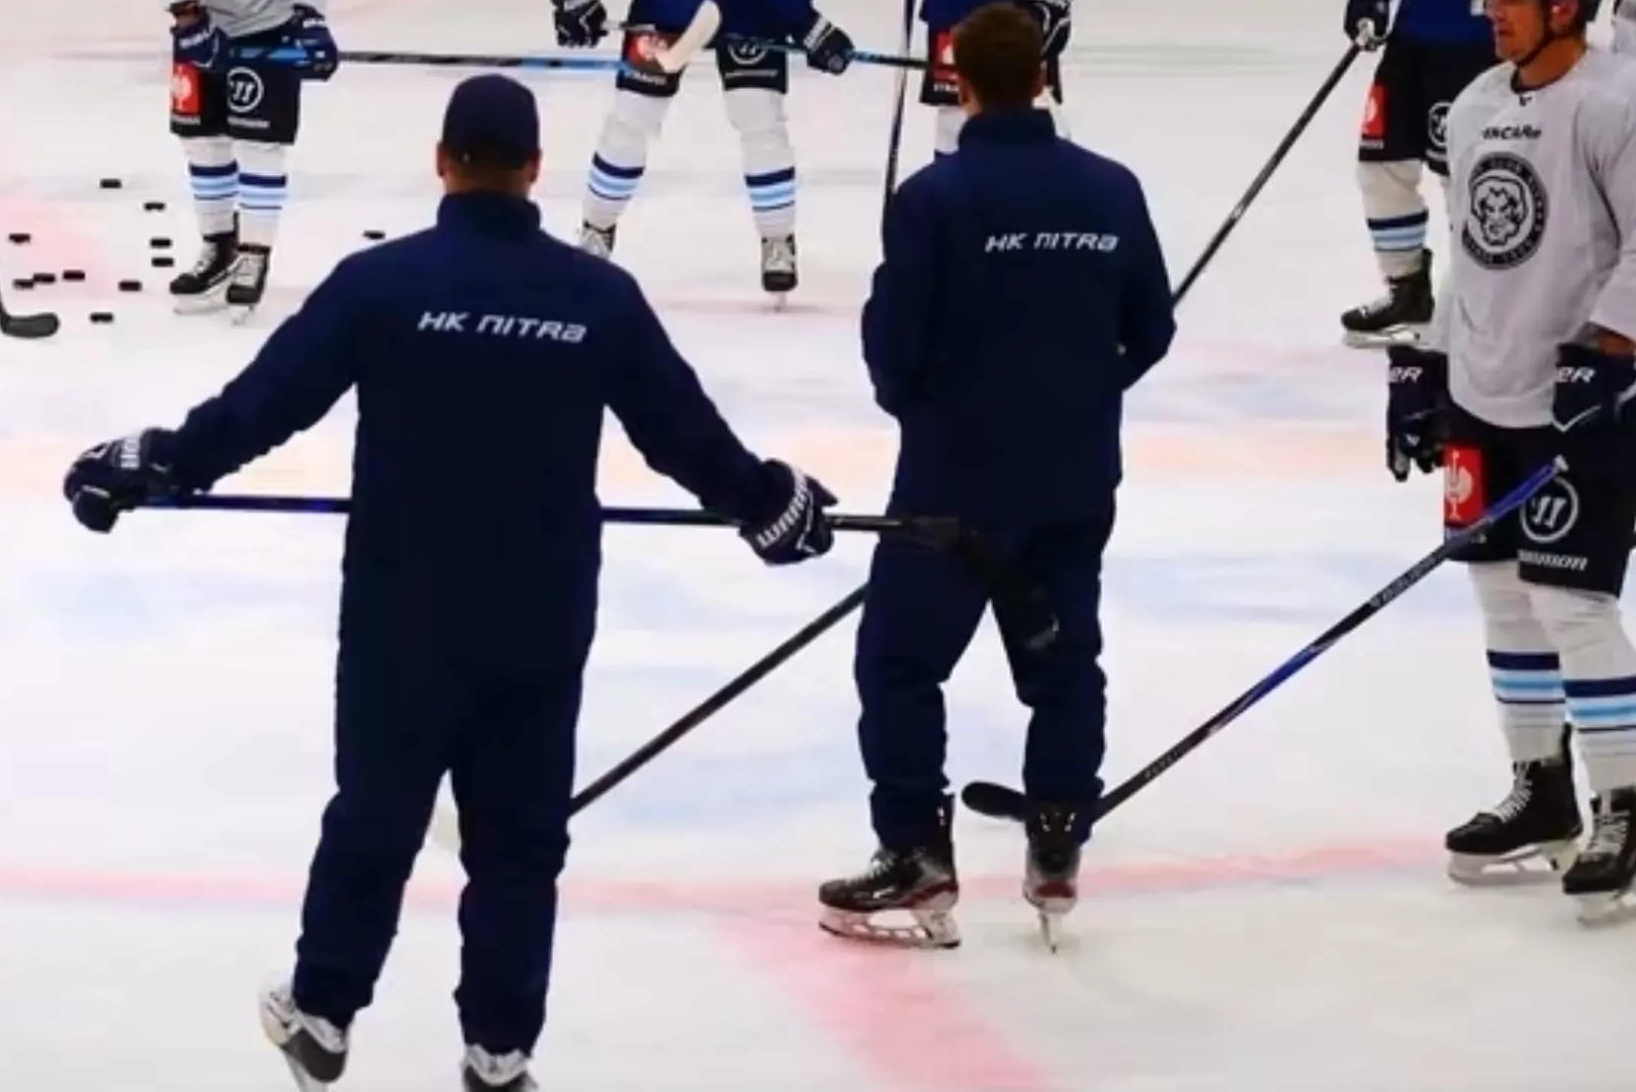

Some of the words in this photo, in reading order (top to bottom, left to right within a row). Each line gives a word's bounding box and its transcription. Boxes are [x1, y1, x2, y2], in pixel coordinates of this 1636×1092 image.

[984, 233, 1028, 253] HK
[1033, 231, 1119, 253] NITRA
[417, 311, 470, 331] HK
[475, 313, 588, 343] NITRA
